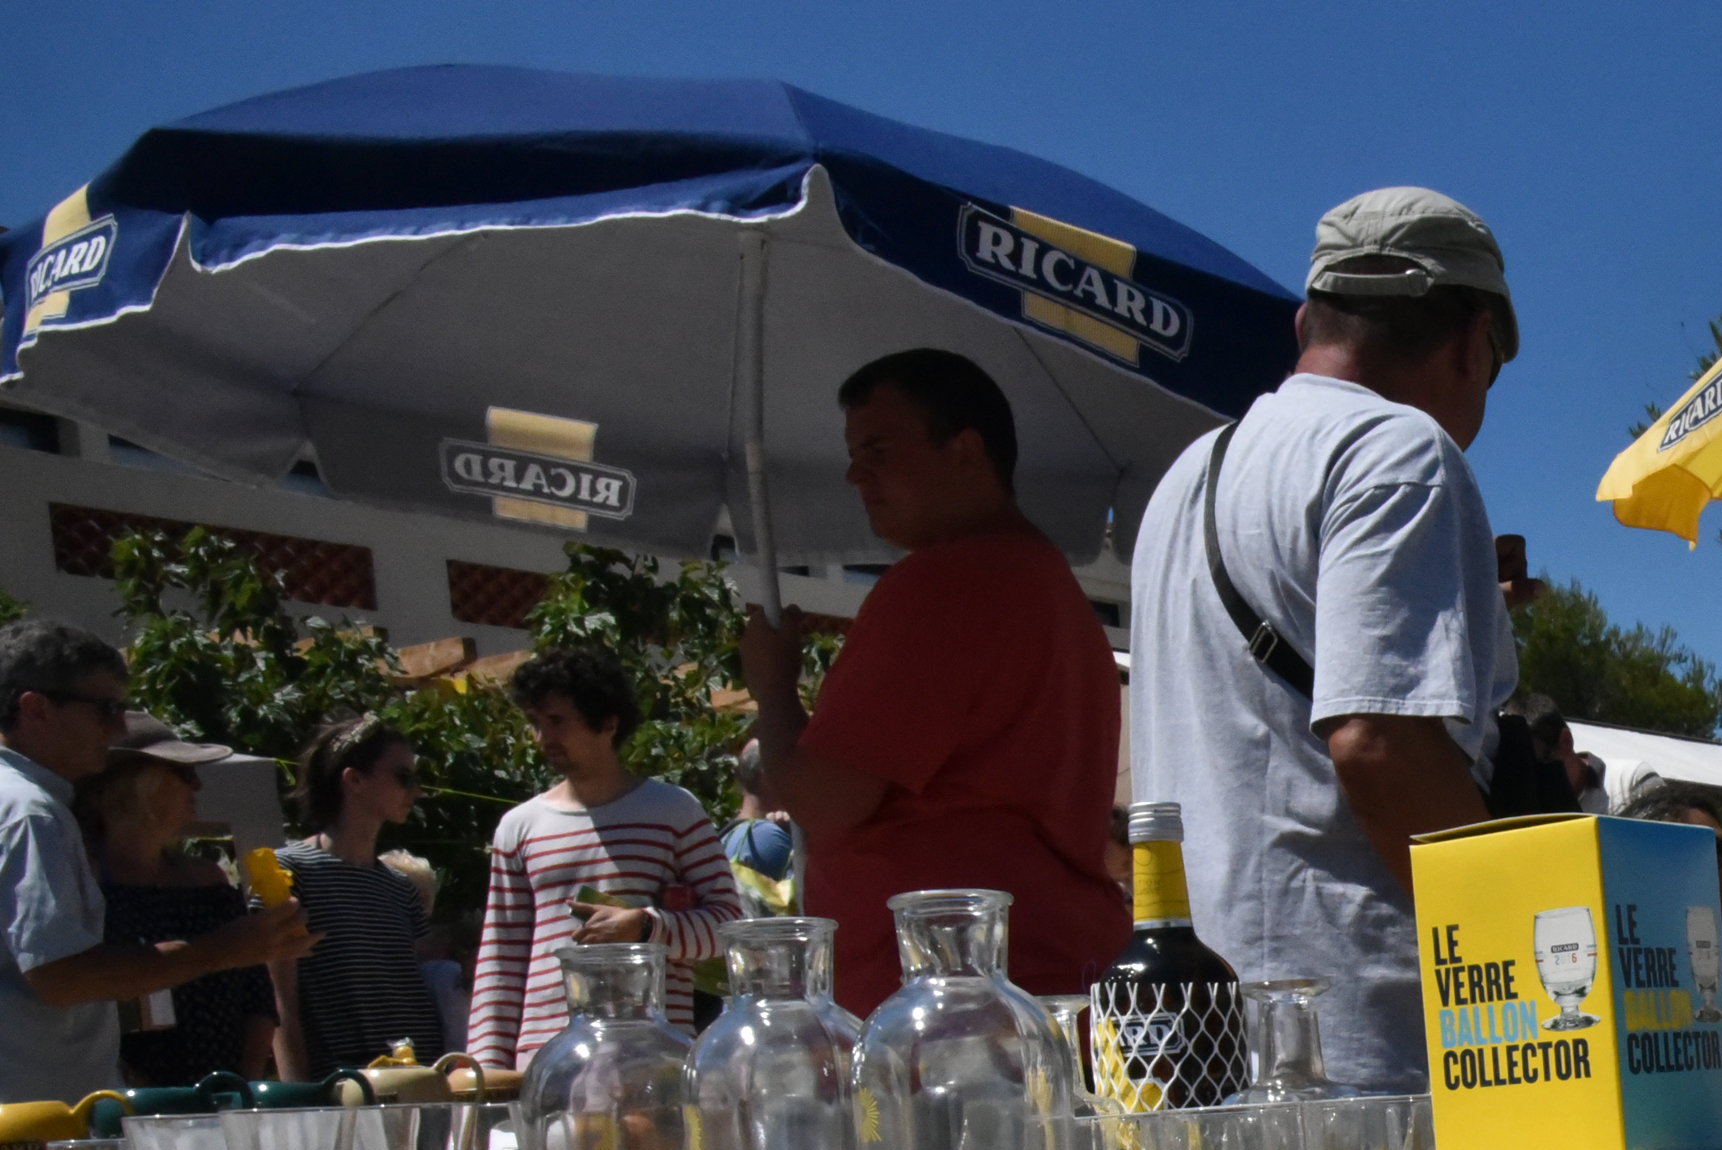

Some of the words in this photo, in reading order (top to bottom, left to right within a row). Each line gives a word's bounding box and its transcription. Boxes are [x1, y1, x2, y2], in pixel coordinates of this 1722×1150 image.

[976, 221, 1181, 337] RICARD
[1432, 924, 1463, 967] LE
[1615, 904, 1640, 945] LE
[1552, 943, 1578, 952] RICARD
[1618, 947, 1679, 988] VERRE
[1434, 959, 1519, 1007] VERRE
[1438, 1000, 1539, 1050] BALLON
[1443, 1038, 1591, 1091] COLLECTOR
[1627, 1030, 1722, 1075] COLLECTOR
